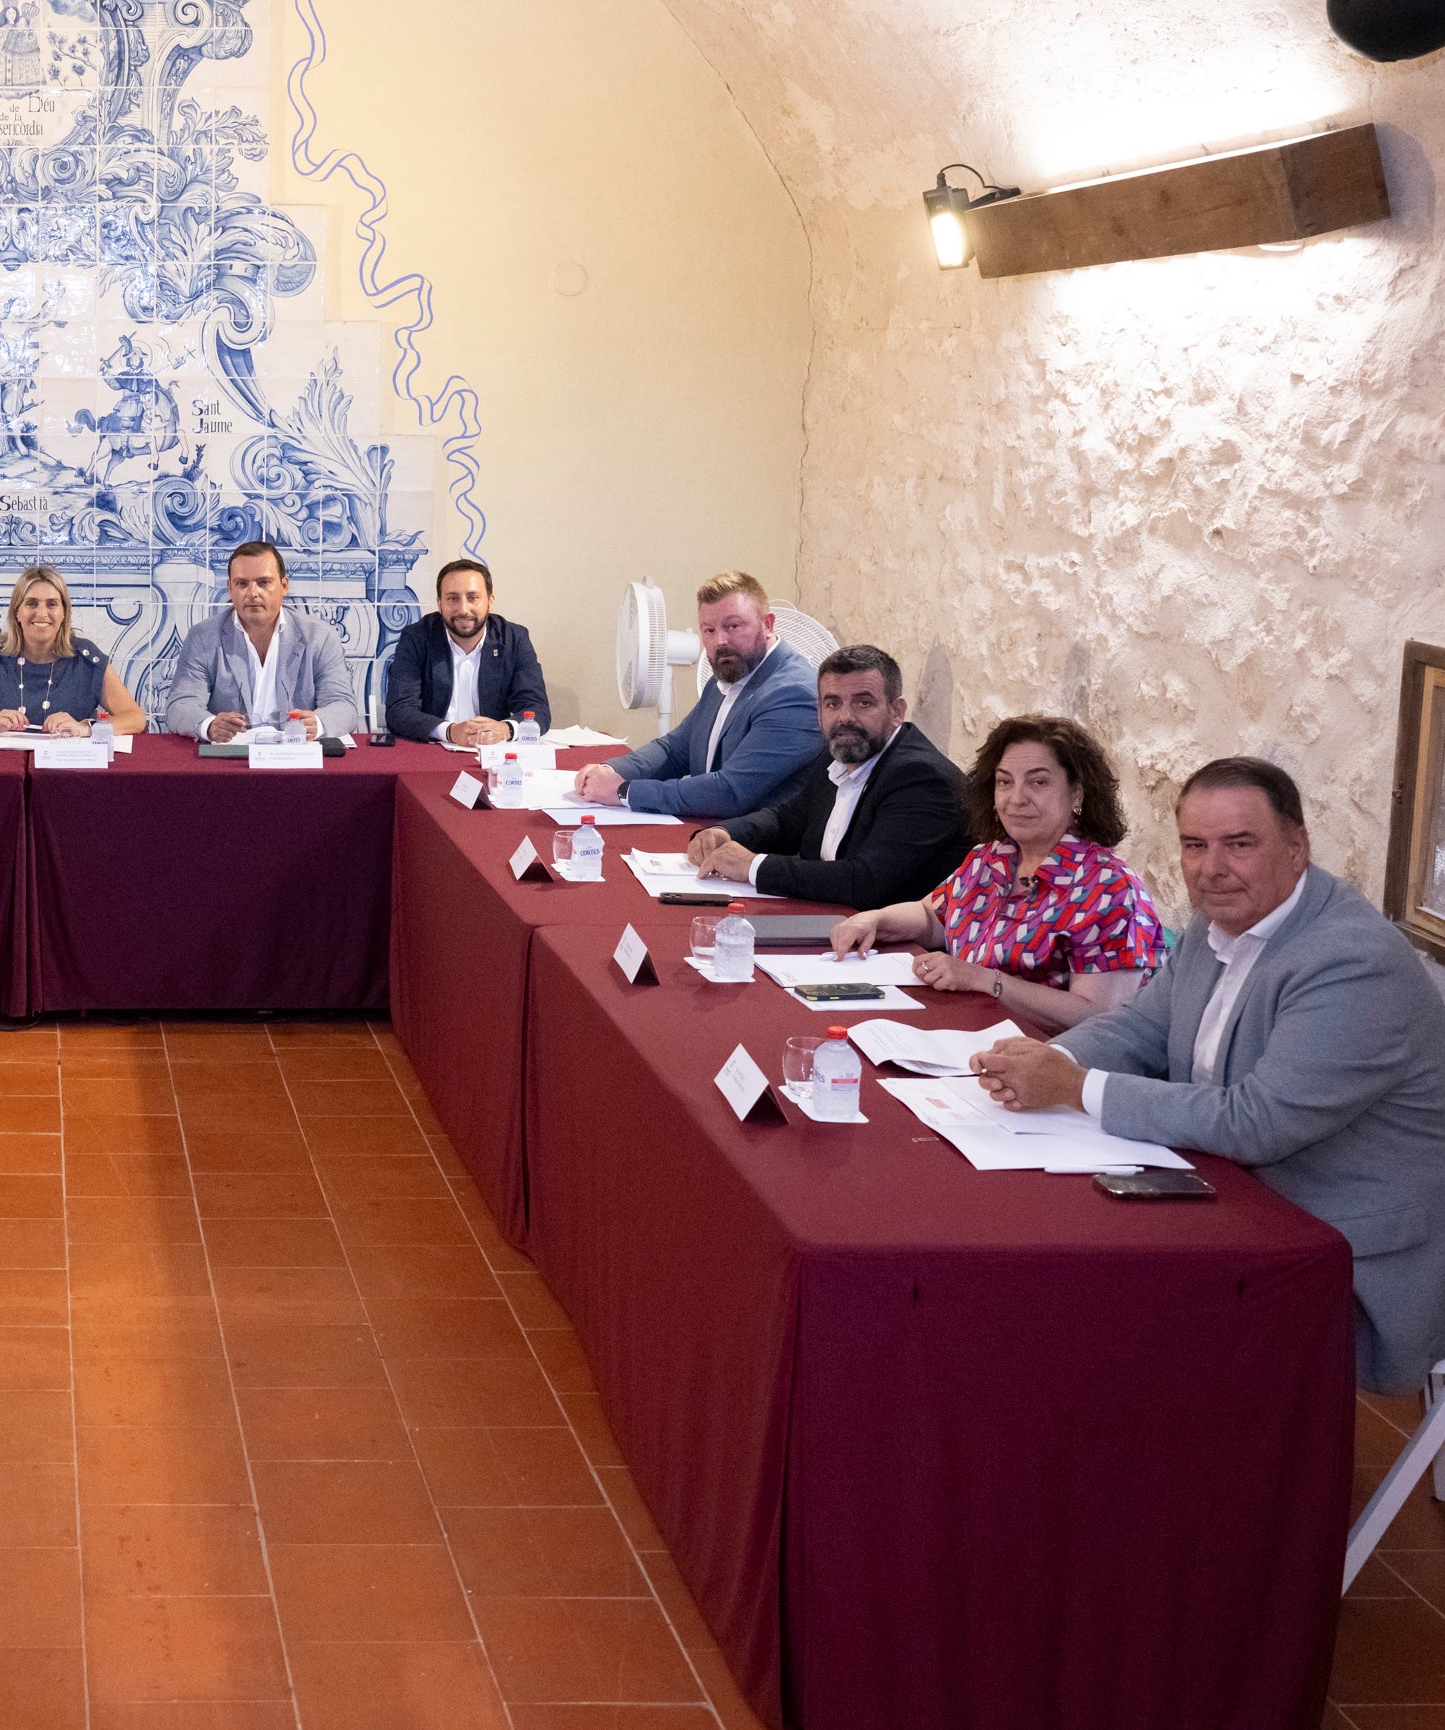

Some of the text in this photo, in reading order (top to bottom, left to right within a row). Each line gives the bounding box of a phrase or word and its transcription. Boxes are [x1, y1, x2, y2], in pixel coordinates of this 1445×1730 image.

[9, 104, 20, 112] de
[14, 113, 22, 122] la
[191, 399, 222, 417] Sant
[191, 418, 233, 434] Jaume
[0, 494, 48, 512] Sebastià
[580, 848, 601, 857] CORTES
